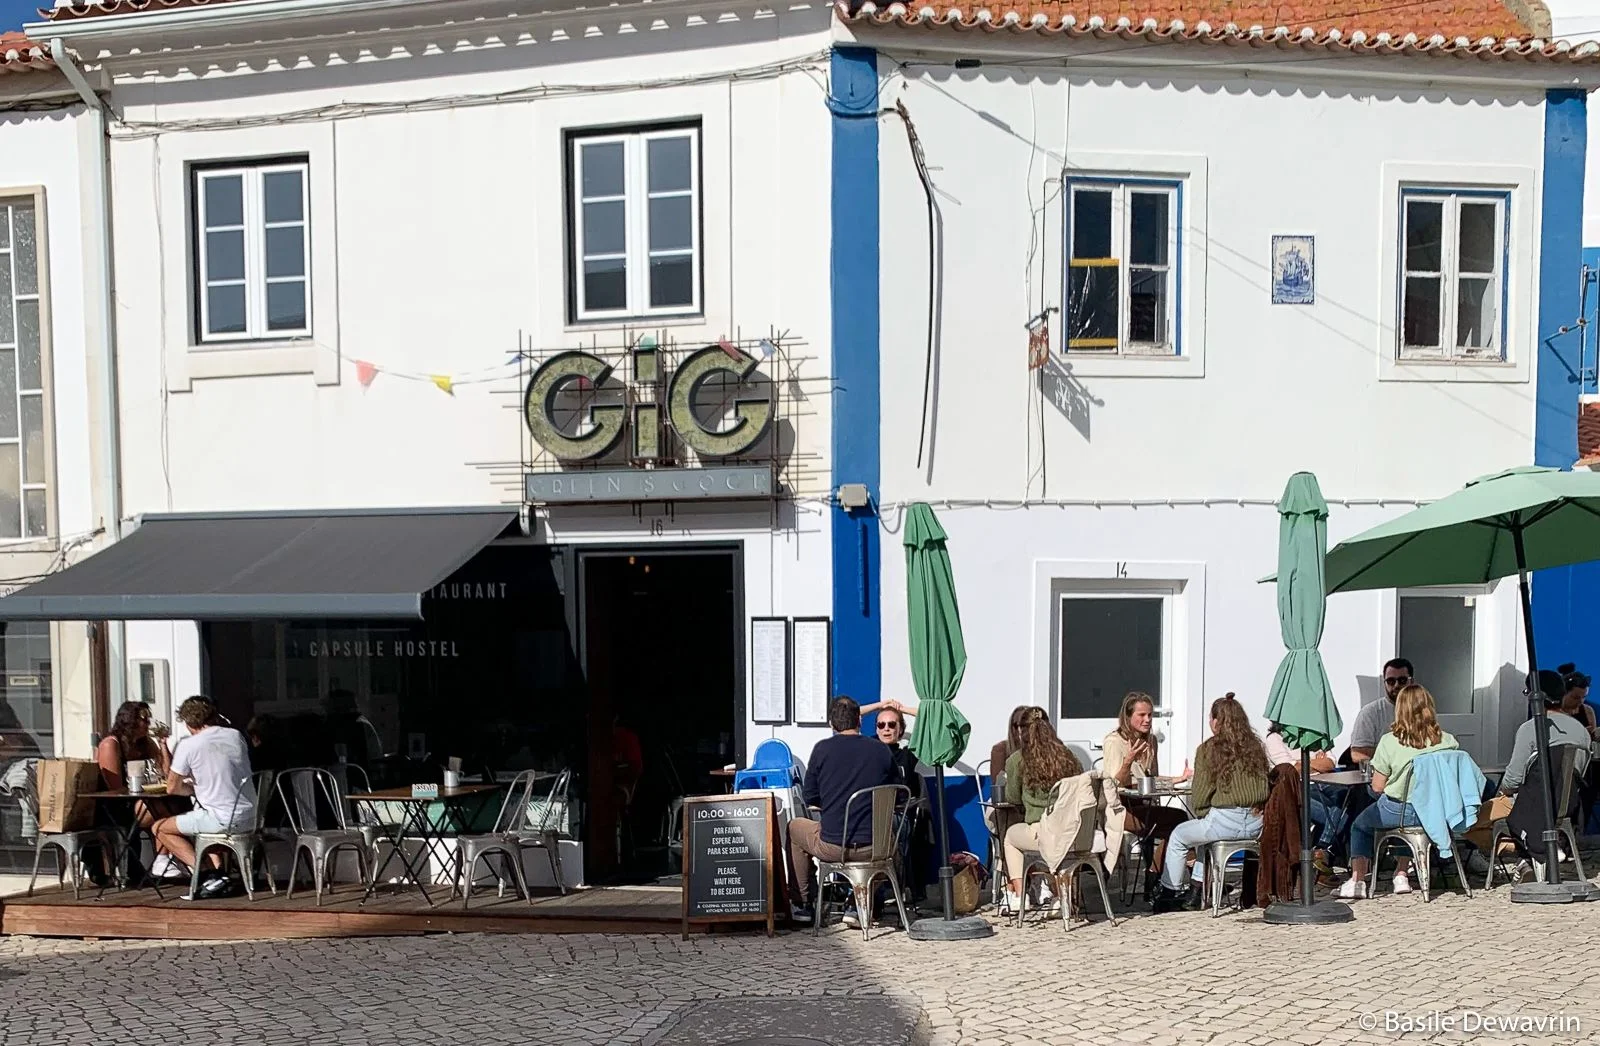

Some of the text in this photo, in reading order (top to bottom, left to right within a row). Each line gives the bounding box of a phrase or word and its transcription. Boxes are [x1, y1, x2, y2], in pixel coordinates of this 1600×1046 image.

[650, 518, 663, 536] 16
[1116, 561, 1128, 578] 14
[309, 641, 459, 657] CAPSULE HOSTEL
[697, 809, 725, 819] 10:00
[733, 807, 759, 817] 16:00
[713, 827, 725, 835] POR
[712, 837, 731, 845] ESPERE
[707, 846, 749, 855] PARA SE SENTAR
[713, 877, 742, 885] WAIT HERE
[710, 887, 745, 896] TO BE SEATED
